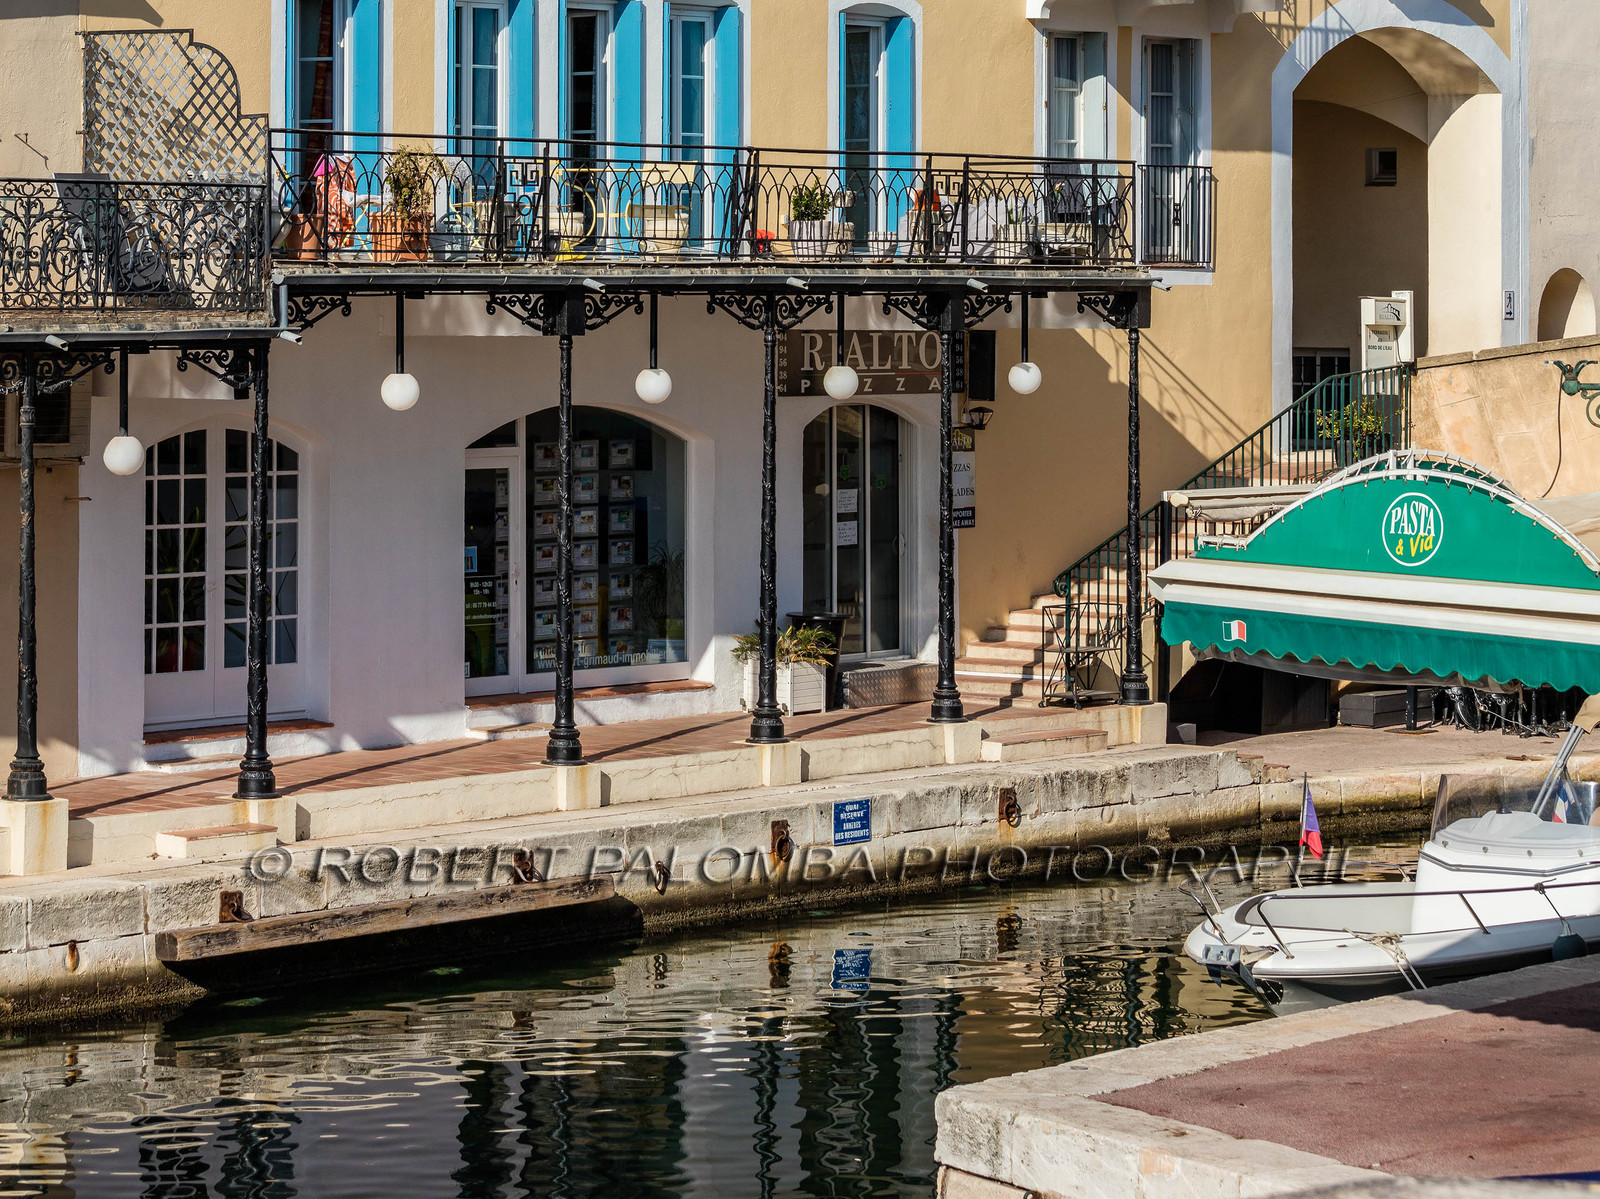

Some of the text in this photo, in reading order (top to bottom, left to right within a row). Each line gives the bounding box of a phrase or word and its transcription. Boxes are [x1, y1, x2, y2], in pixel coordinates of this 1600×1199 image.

[801, 331, 942, 371] RIALTO
[801, 377, 942, 393] PZZA
[952, 436, 972, 446] ALTO
[953, 463, 971, 473] ZZAS
[1389, 501, 1435, 536] PASTA
[1395, 533, 1433, 557] & Via
[835, 832, 844, 840] DES
